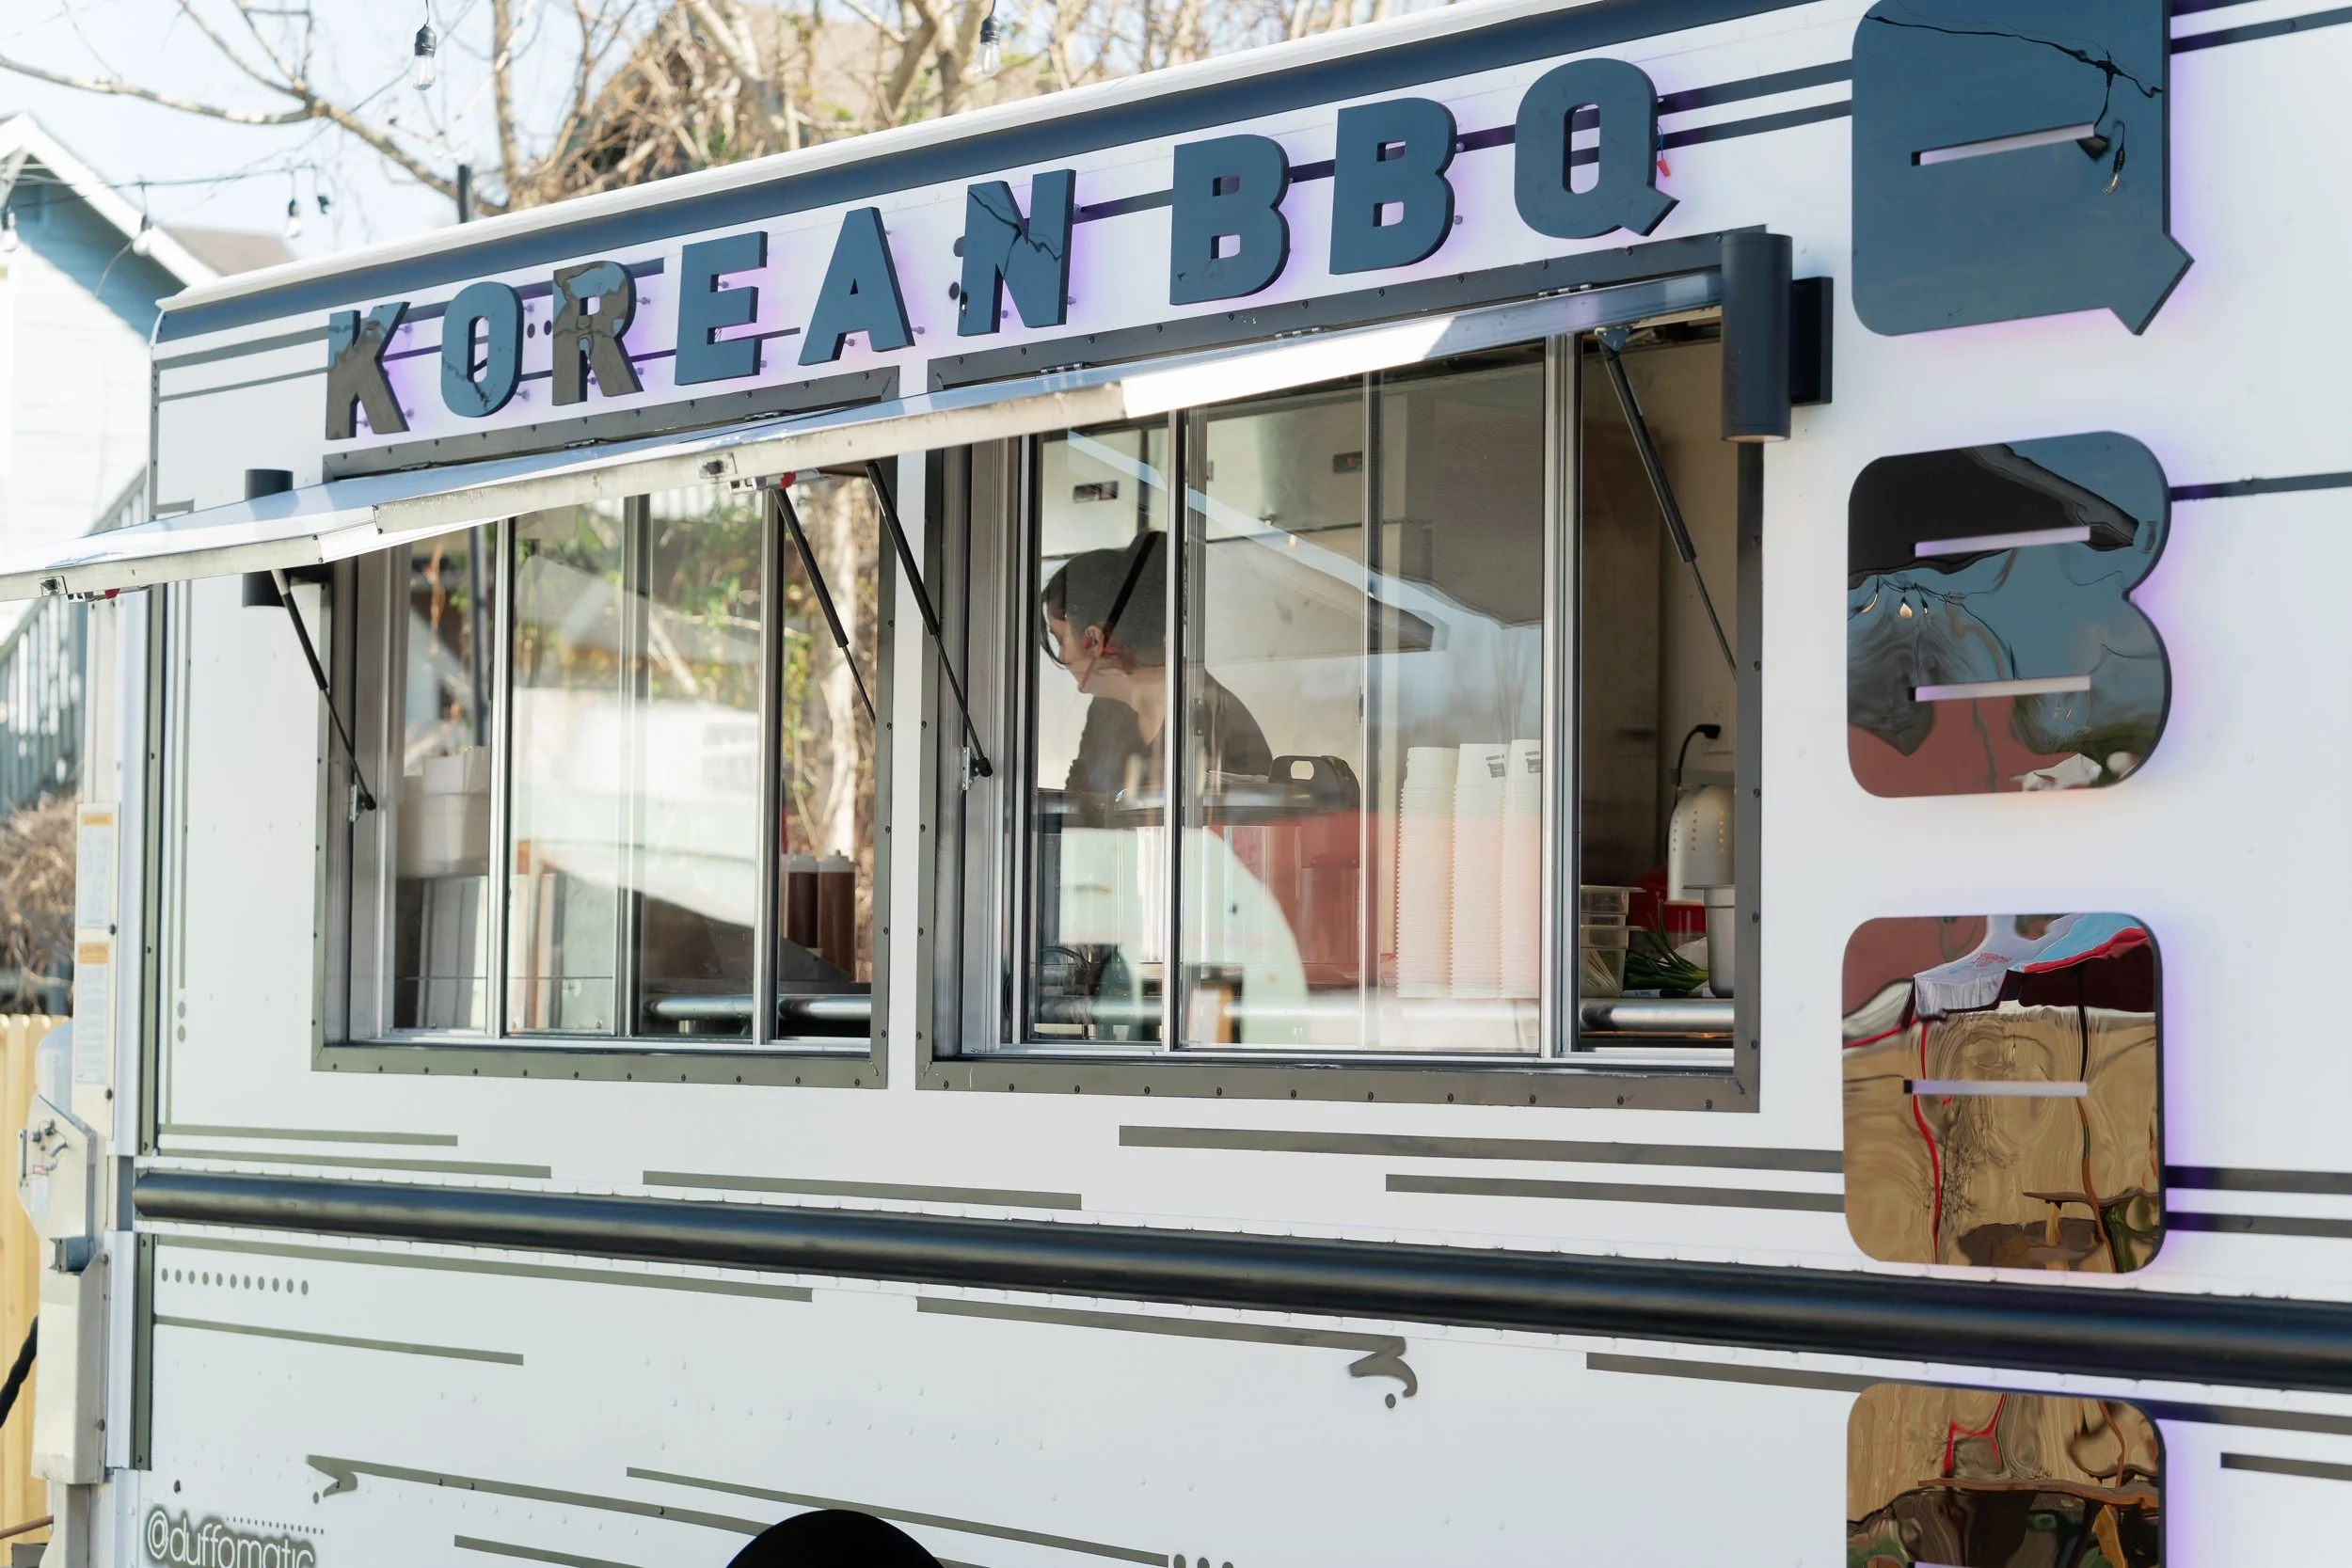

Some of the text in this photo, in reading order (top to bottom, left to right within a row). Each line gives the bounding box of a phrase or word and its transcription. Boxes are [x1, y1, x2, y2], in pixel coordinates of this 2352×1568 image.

[326, 57, 1679, 439] KOREAN BBQ
[147, 1511, 314, 1568] @duffomatic
